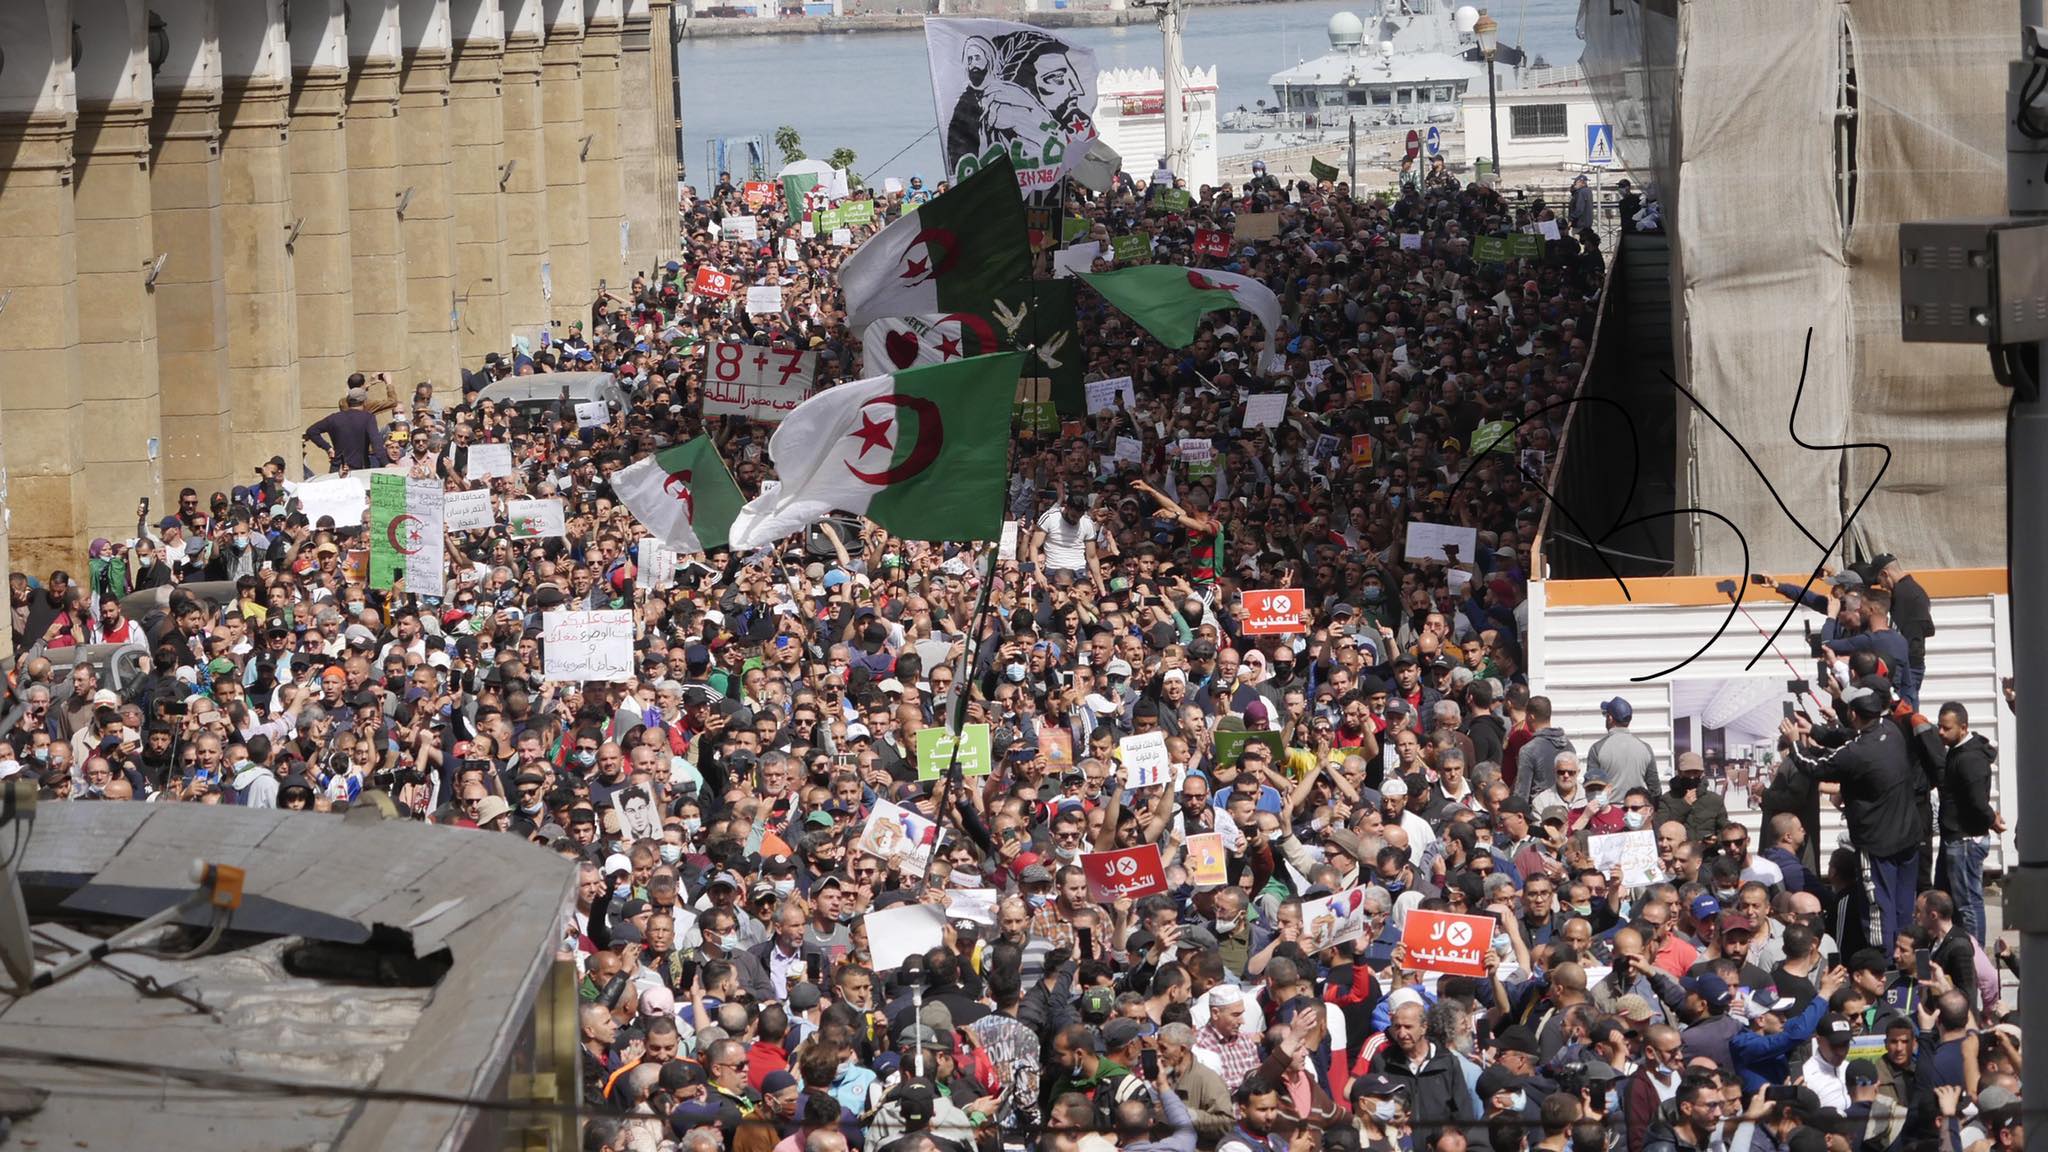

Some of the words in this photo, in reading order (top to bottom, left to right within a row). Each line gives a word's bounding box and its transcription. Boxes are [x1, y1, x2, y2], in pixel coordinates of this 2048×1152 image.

[1261, 596, 1271, 611] لا
[1249, 613, 1299, 629] للتعذيب
[1104, 860, 1115, 877] لا
[1100, 874, 1155, 897] للتخوين
[1430, 920, 1446, 941] لا
[1410, 946, 1480, 966] للتعذيب
